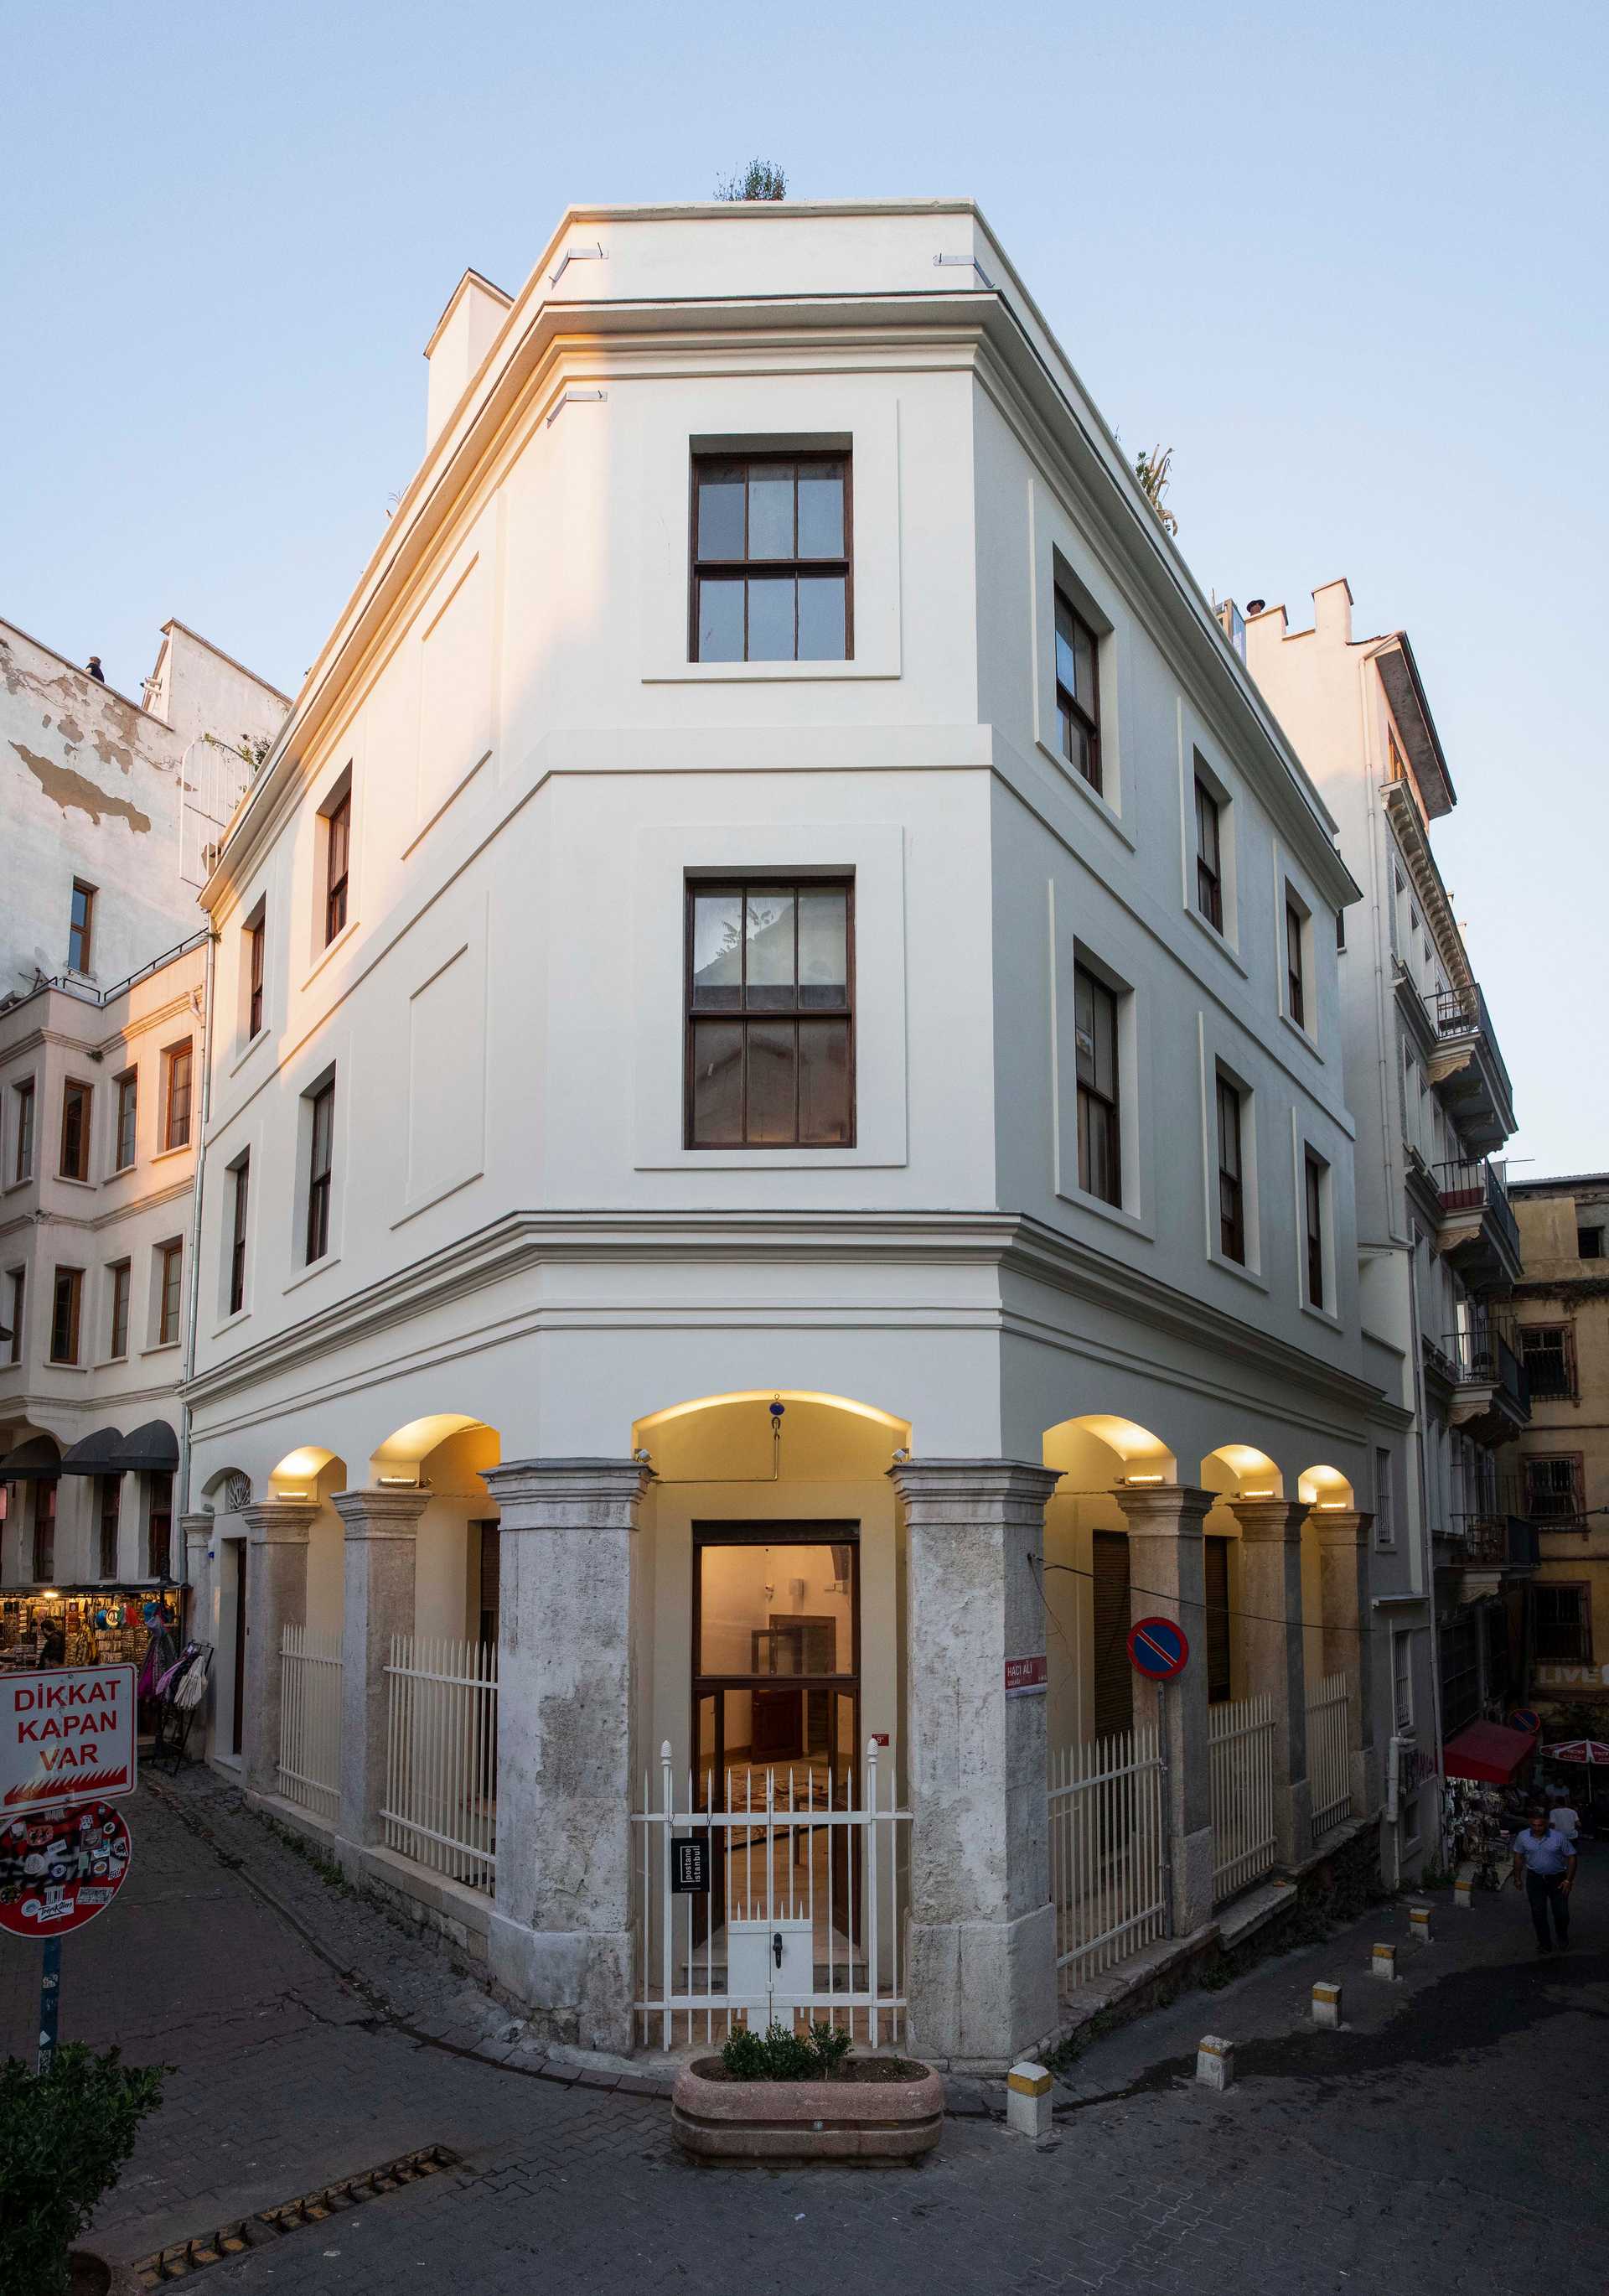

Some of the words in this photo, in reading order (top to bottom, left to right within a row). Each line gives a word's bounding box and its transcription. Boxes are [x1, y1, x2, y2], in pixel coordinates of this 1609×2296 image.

[1007, 1665, 1022, 1677] HACI
[14, 1680, 122, 1712] DİKKAT
[18, 1710, 117, 1744] KAPAN
[39, 1744, 99, 1771] VAR
[685, 1848, 693, 1880] postane
[693, 1848, 701, 1883] istanbul
